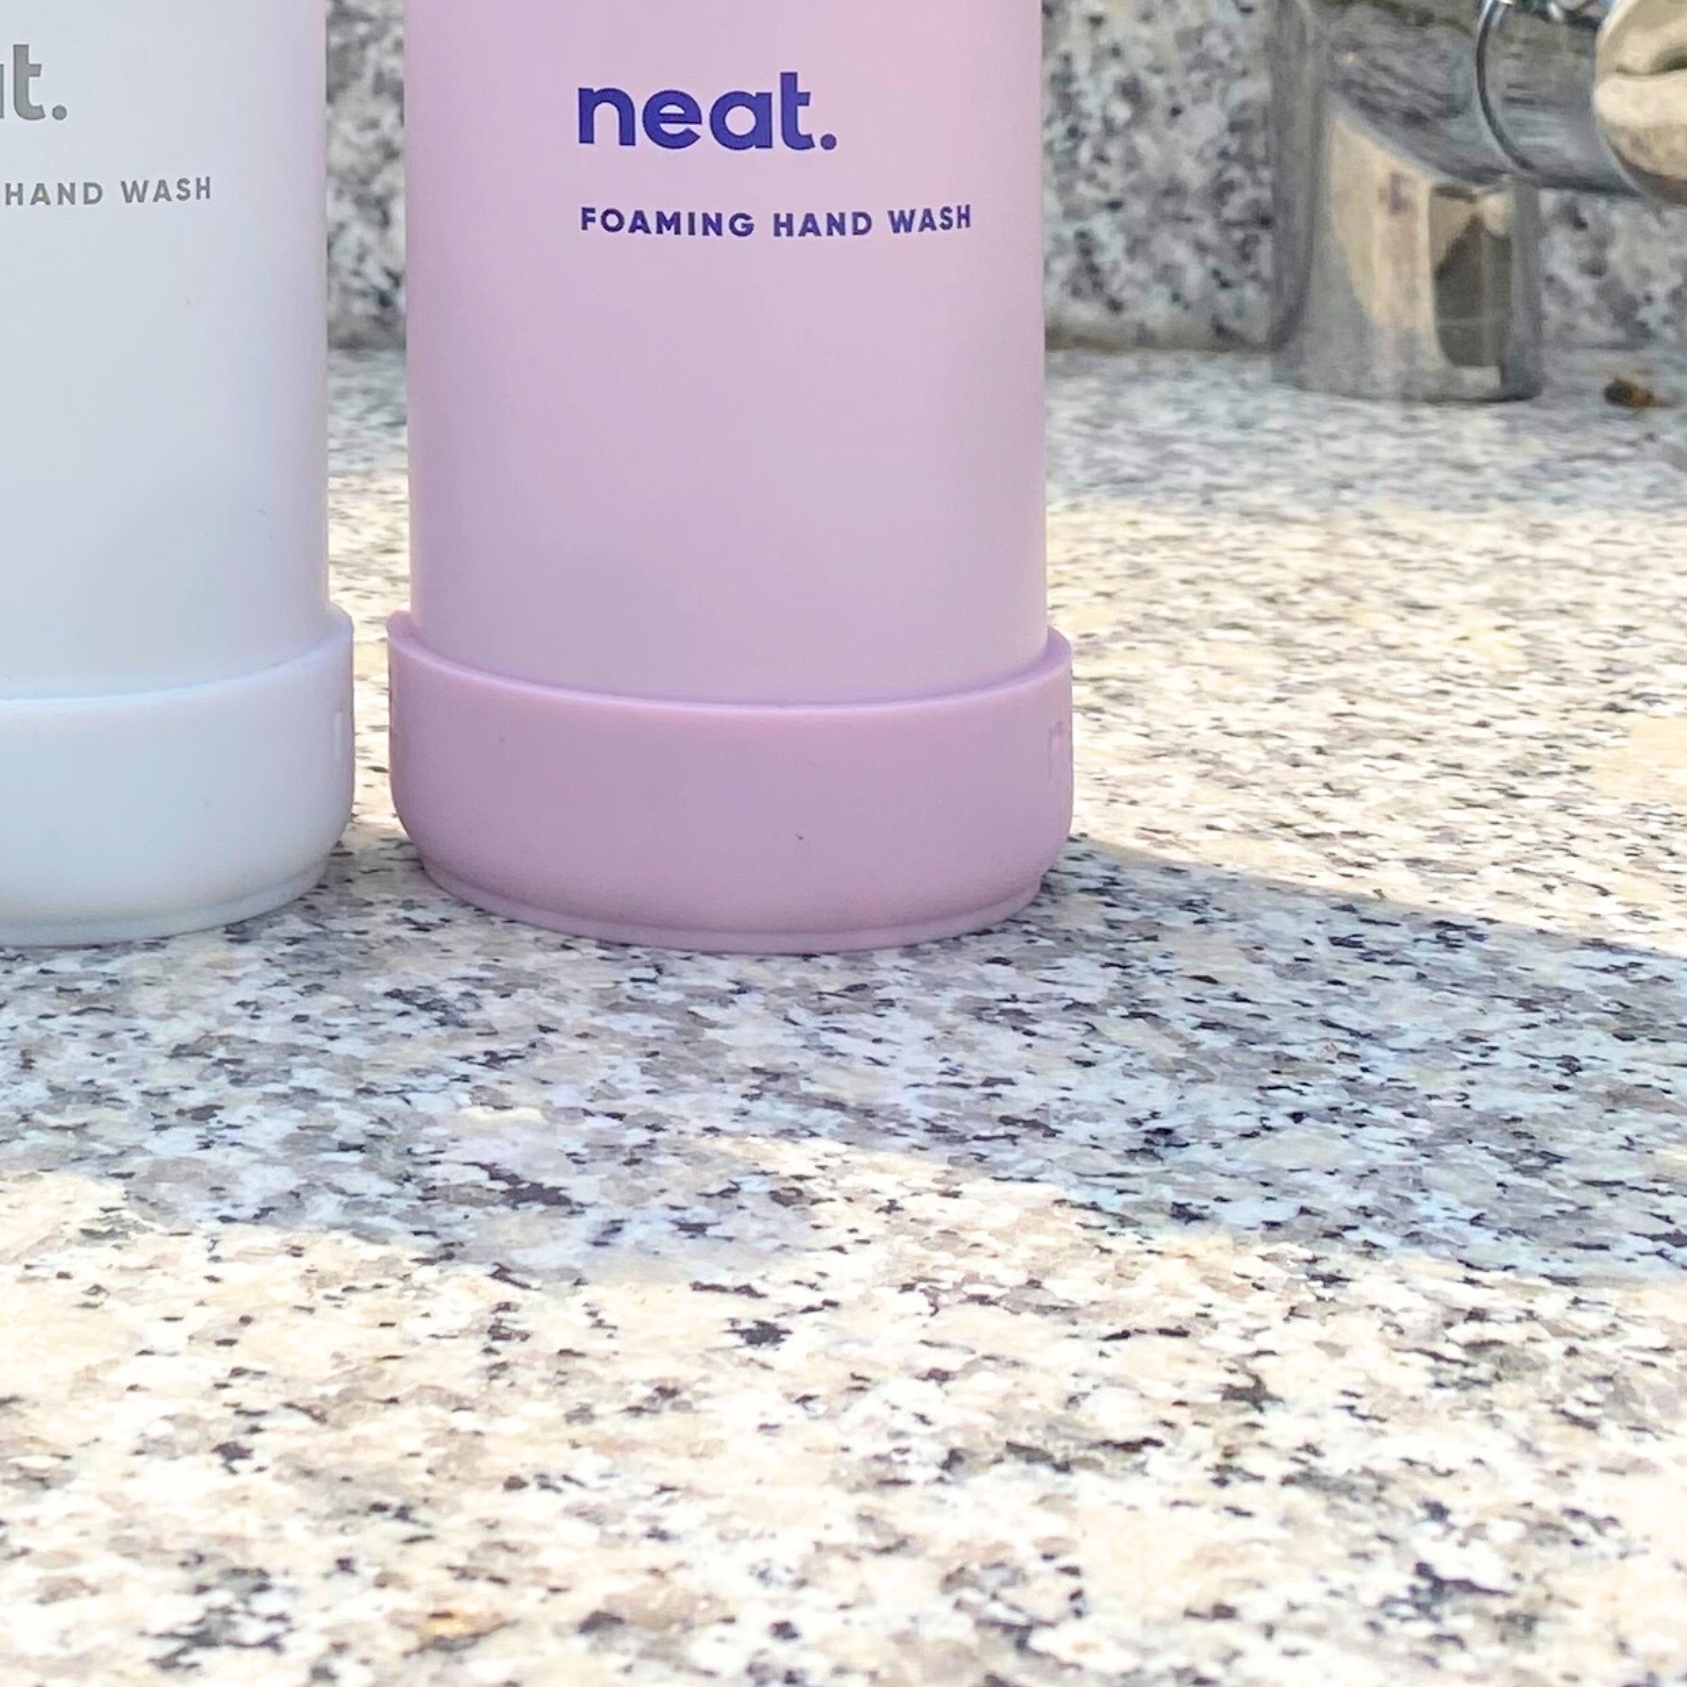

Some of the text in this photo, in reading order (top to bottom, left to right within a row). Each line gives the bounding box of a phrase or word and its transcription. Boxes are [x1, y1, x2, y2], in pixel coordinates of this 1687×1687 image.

[577, 71, 838, 151] neat.
[4, 181, 103, 206] HAND
[120, 175, 211, 204] WASH
[581, 204, 972, 238] FOAMING HAND WASH
